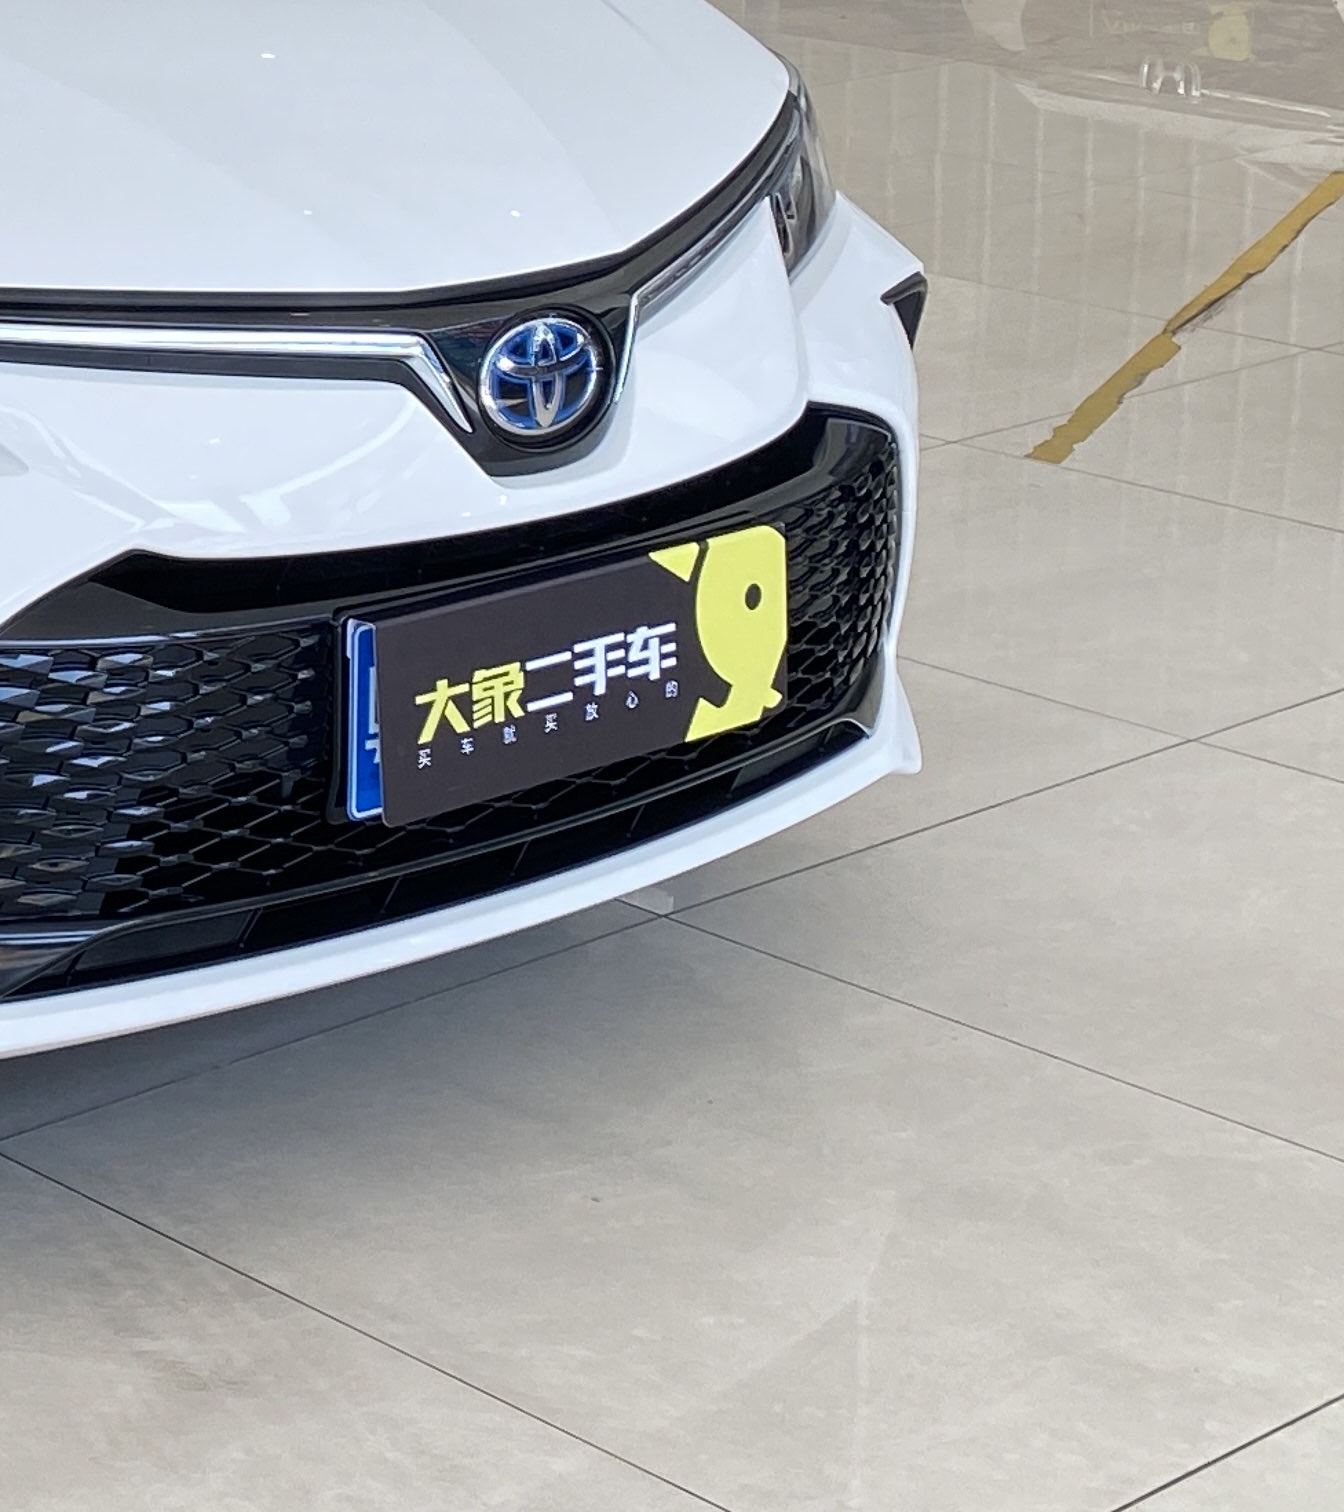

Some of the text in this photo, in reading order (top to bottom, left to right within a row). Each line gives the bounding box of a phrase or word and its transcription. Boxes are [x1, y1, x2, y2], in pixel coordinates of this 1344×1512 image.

[413, 621, 679, 746] 大象二手车
[417, 678, 680, 770] 买车就买放心的
